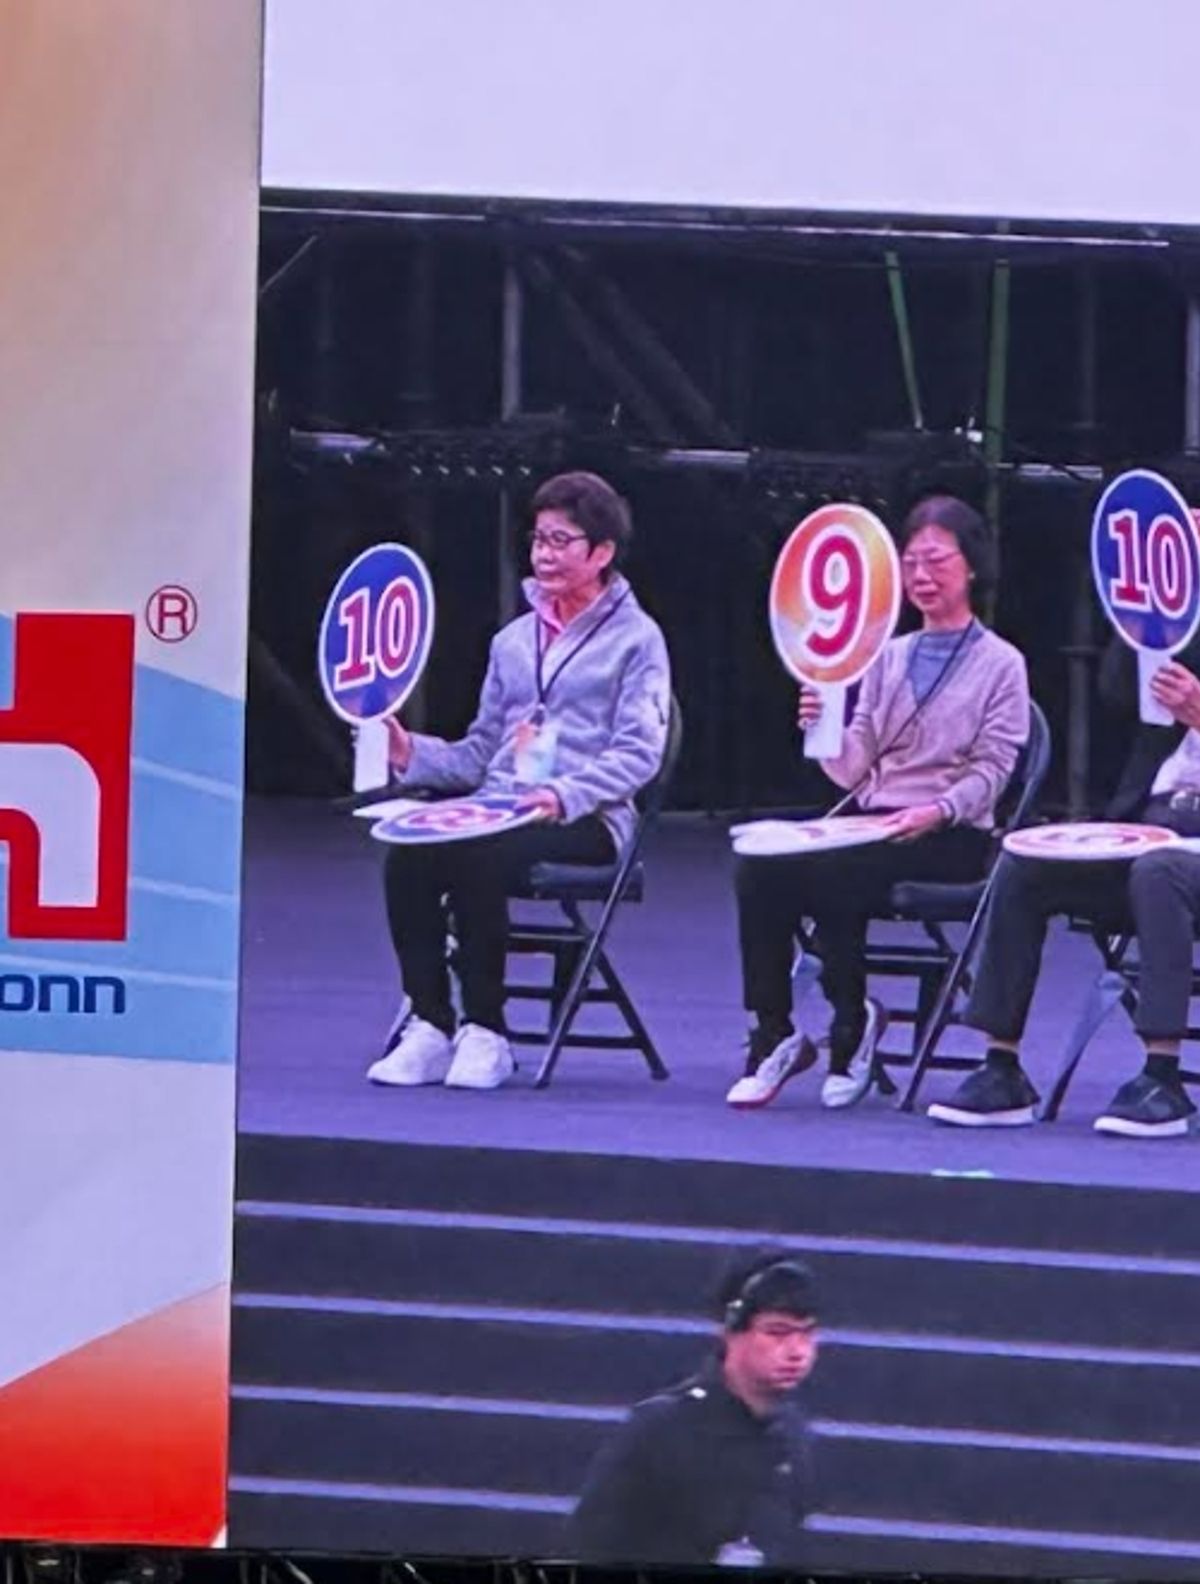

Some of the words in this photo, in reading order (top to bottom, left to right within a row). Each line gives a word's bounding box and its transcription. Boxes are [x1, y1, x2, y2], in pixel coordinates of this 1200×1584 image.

[803, 527, 868, 665] 9
[1108, 508, 1193, 620] 10
[333, 575, 421, 692] 10
[0, 974, 126, 1014] onn
